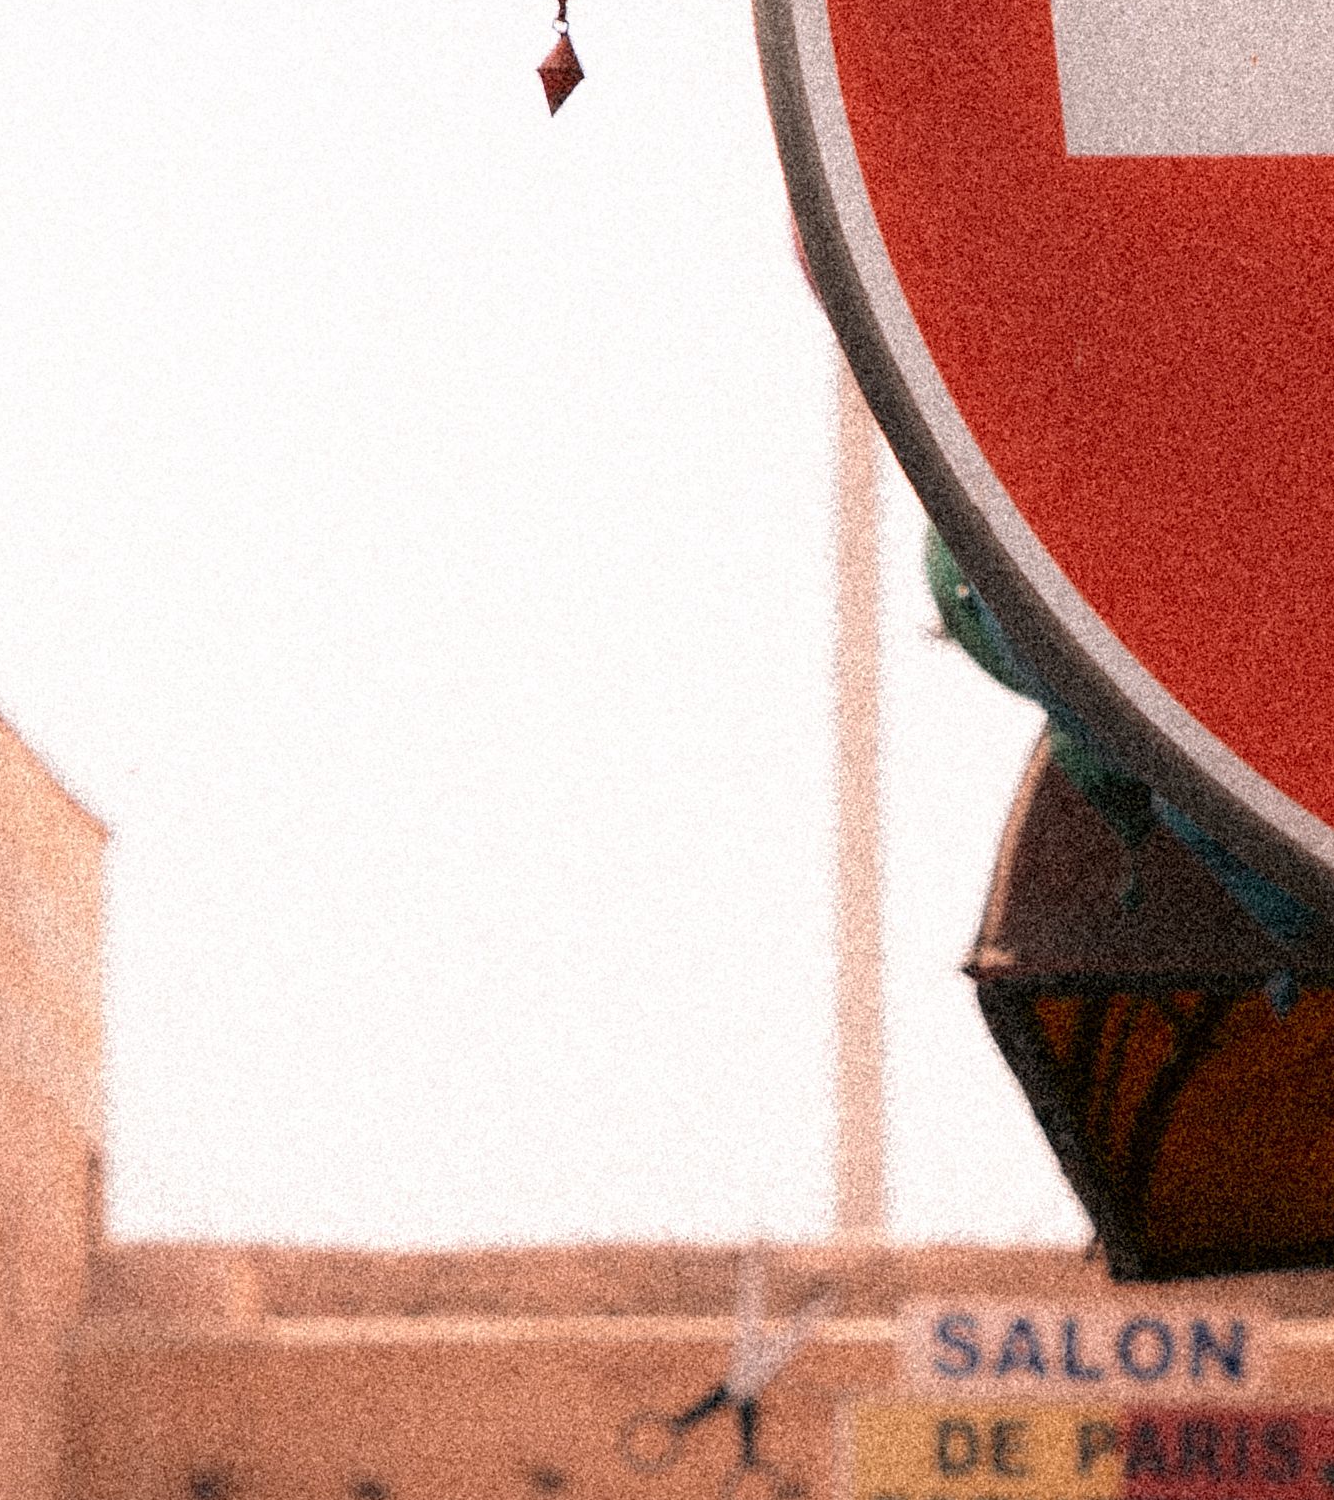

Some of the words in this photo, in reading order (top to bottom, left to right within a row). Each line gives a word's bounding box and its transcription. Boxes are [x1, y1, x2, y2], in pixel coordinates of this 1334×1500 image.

[933, 1315, 1246, 1382] SALON
[935, 1420, 1027, 1478] DE
[1078, 1421, 1303, 1483] PARIS
